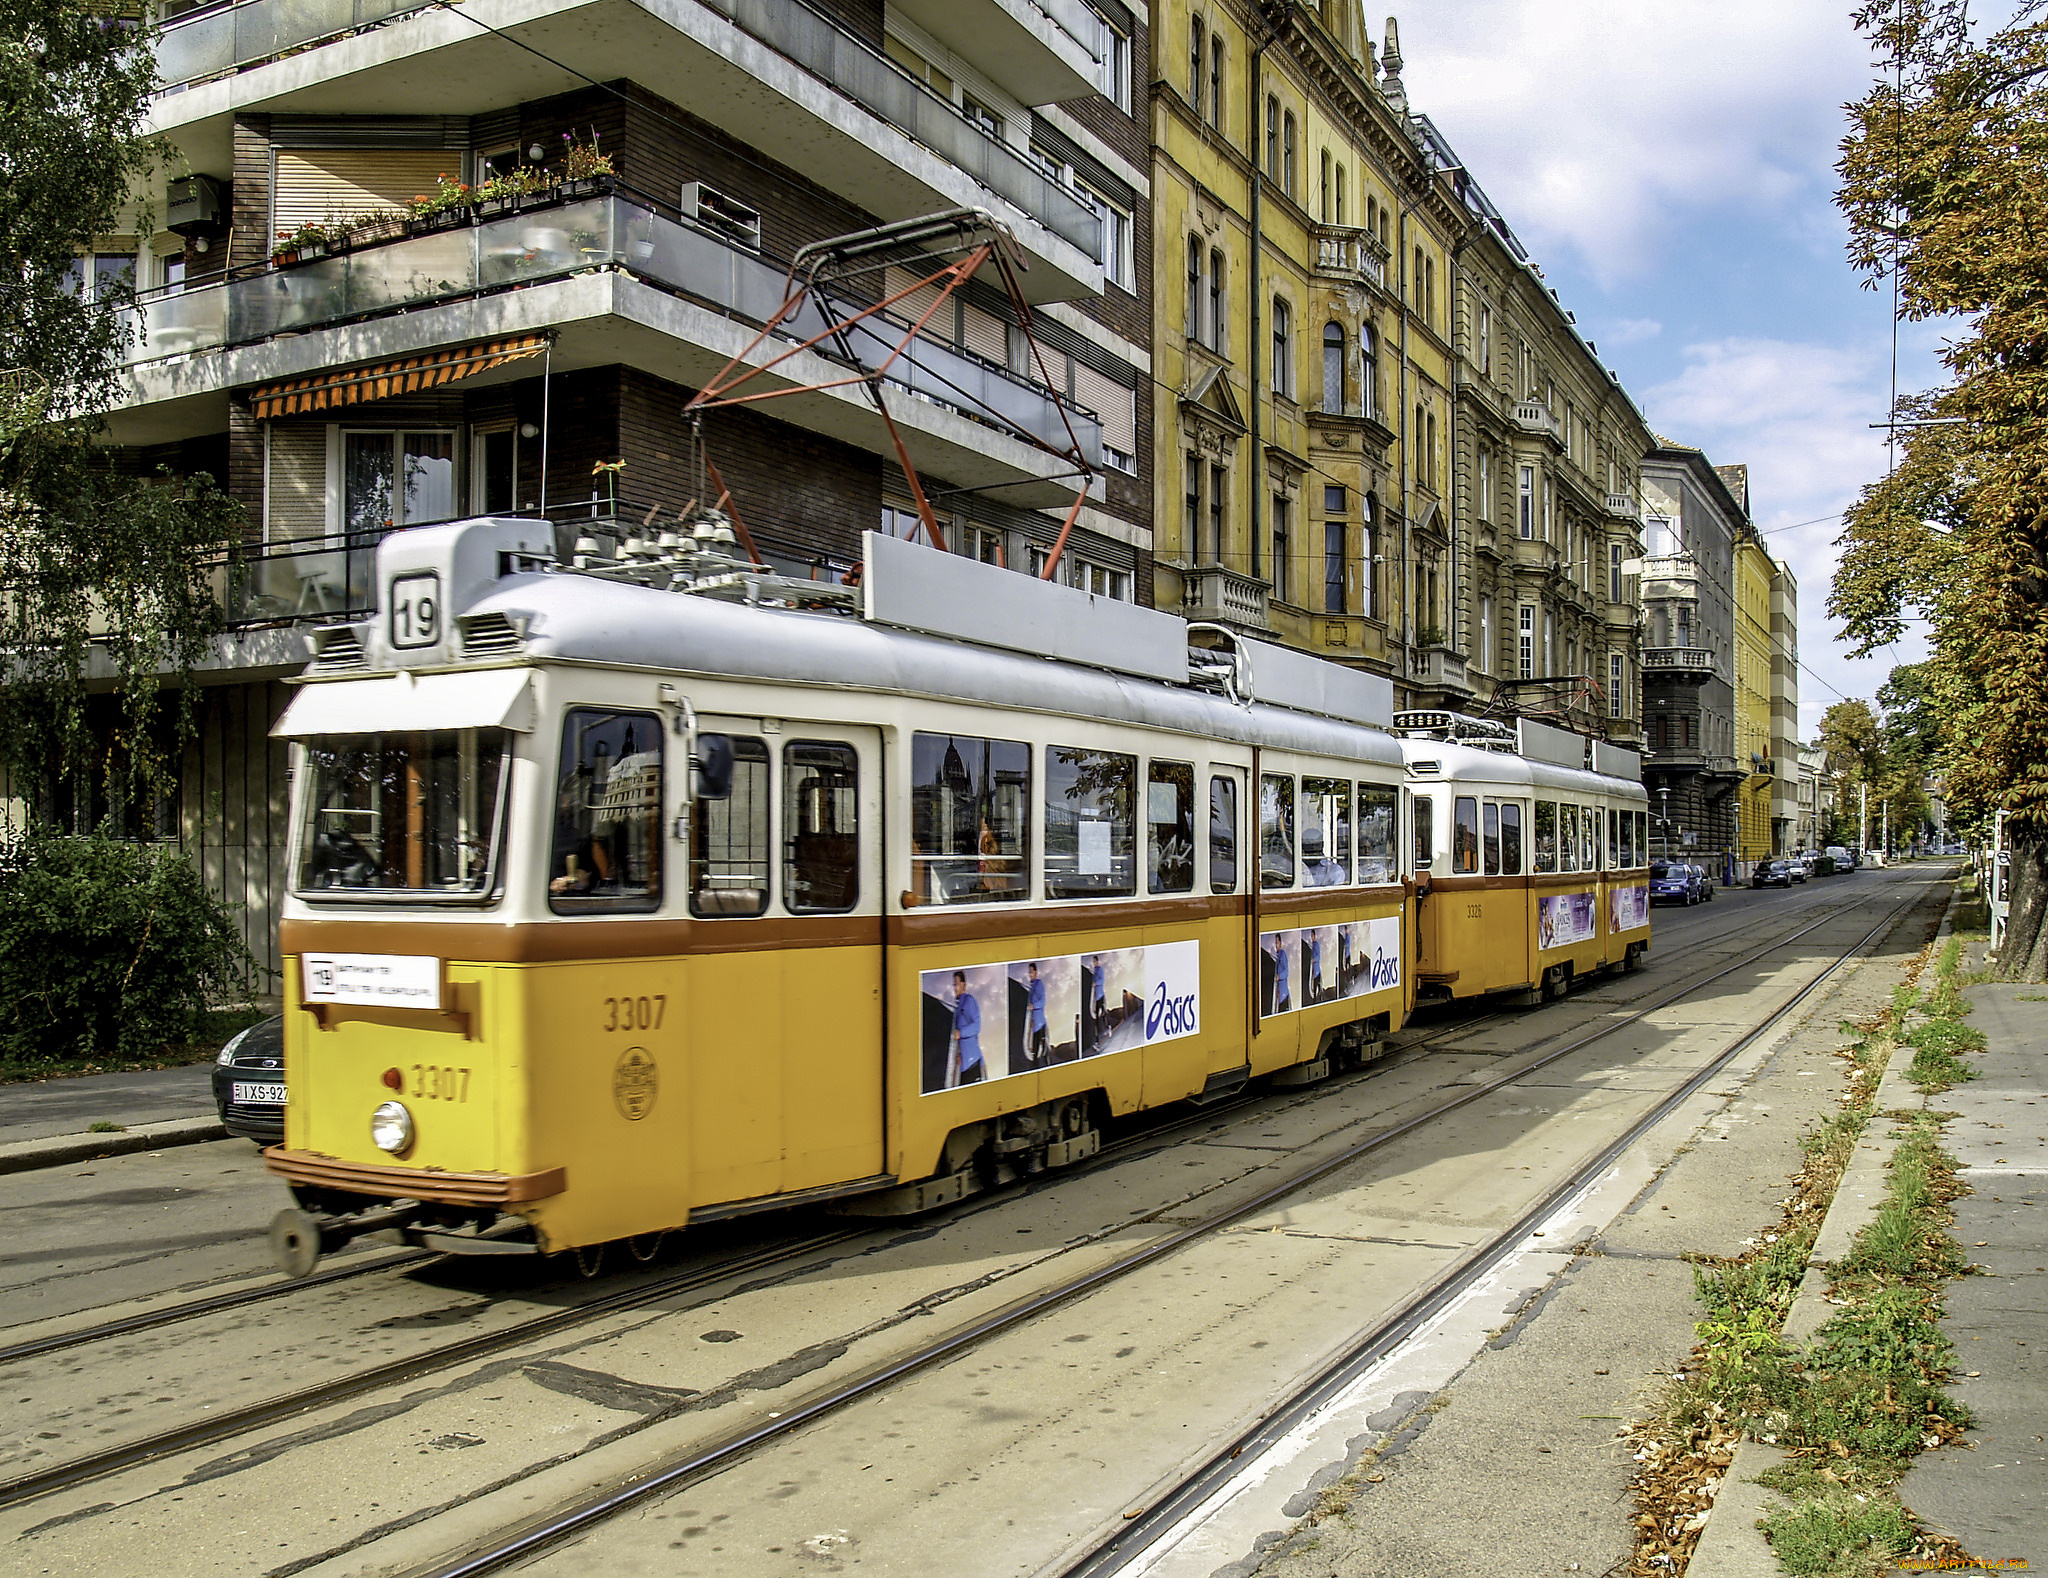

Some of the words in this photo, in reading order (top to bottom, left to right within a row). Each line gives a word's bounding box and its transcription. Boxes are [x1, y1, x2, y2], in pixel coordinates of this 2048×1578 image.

[396, 597, 435, 637] 19
[603, 994, 667, 1032] 3307
[244, 1085, 289, 1100] IXS-927
[411, 1063, 472, 1104] 3307
